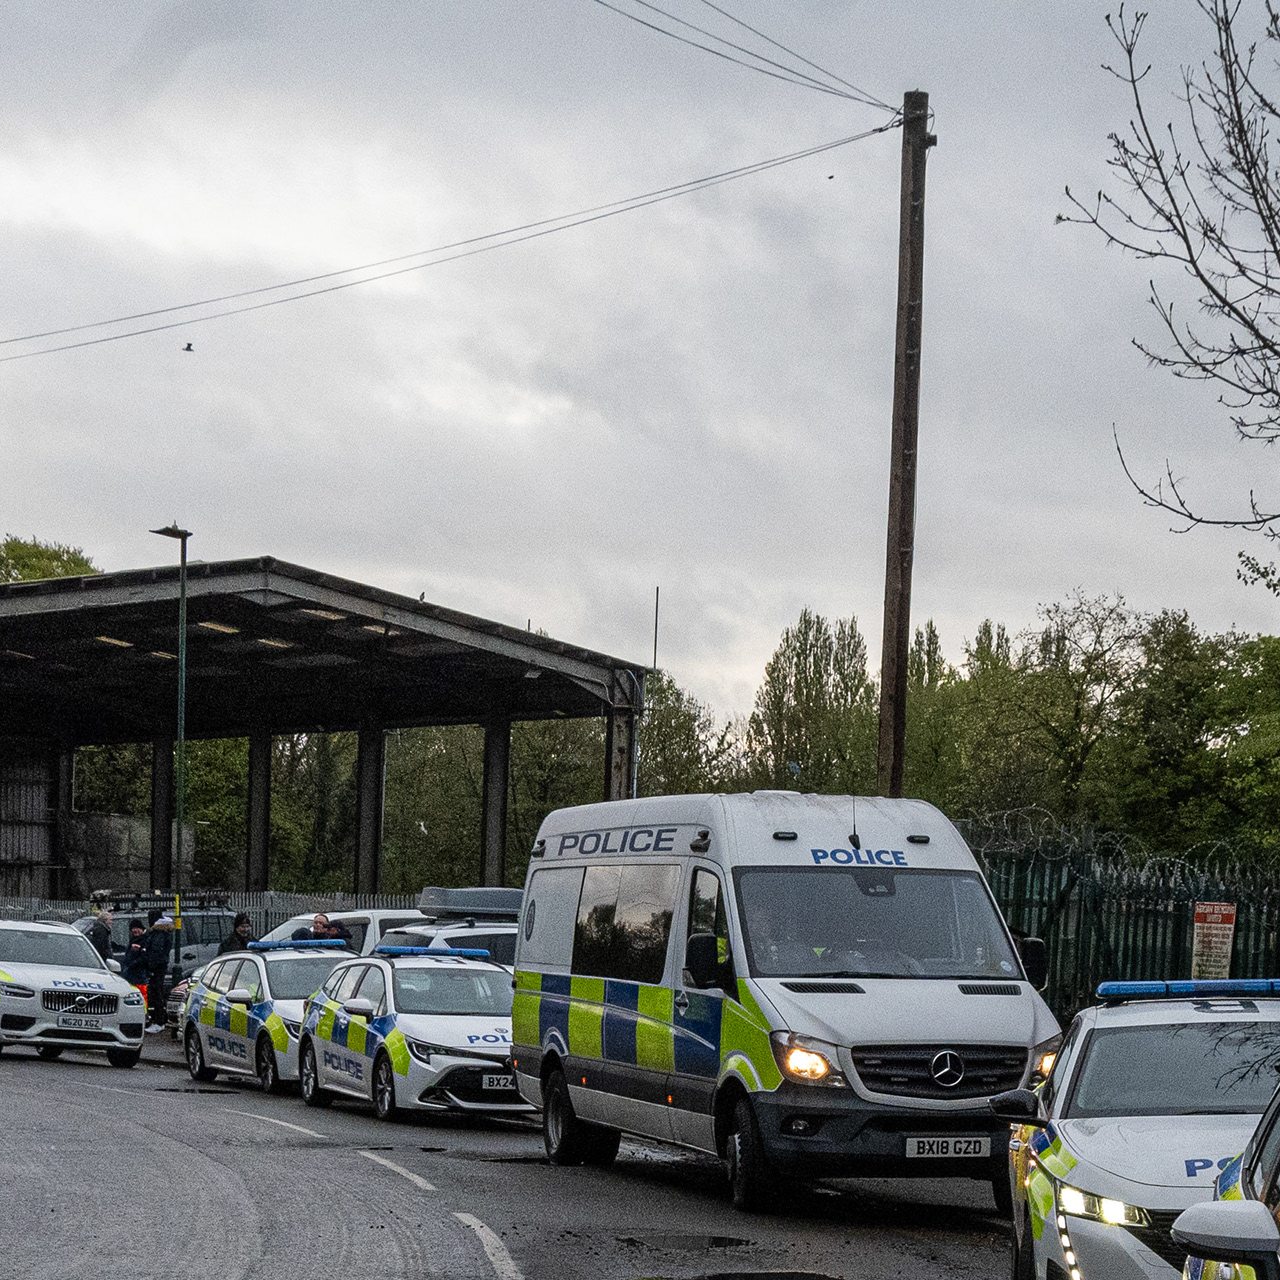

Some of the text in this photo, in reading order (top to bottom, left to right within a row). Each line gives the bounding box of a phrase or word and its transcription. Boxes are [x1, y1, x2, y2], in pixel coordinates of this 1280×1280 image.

[557, 828, 678, 857] POLICE
[810, 848, 909, 866] POLICE
[52, 980, 106, 991] POLICE
[62, 1017, 100, 1028] NG20 XGZ
[208, 1035, 247, 1059] POLICE
[323, 1050, 364, 1081] POLICE
[487, 1077, 515, 1088] BX24
[916, 1140, 982, 1155] BX18 GZD
